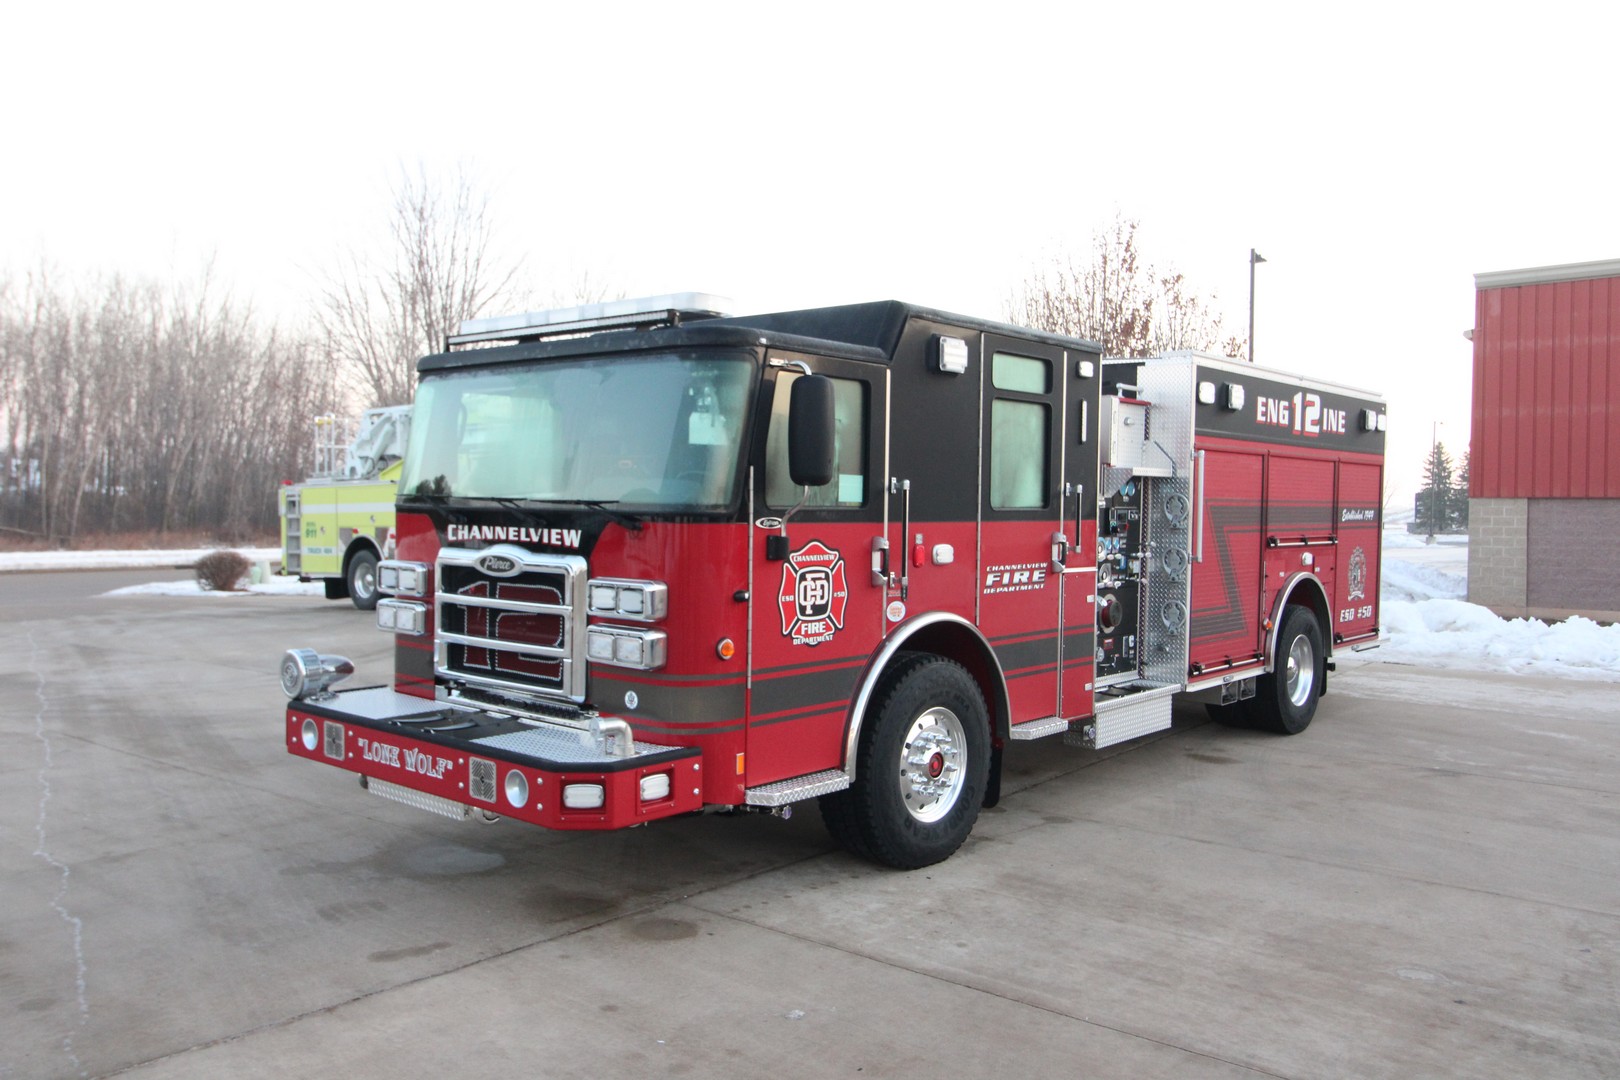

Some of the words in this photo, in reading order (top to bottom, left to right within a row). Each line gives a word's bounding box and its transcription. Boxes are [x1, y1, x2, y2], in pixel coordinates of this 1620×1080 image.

[1256, 396, 1289, 427] ENG
[1292, 392, 1321, 437] 12
[1322, 408, 1346, 434] INE
[447, 524, 582, 548] CHANNELVIEW
[484, 555, 512, 571] Pierce
[793, 554, 835, 563] CHANNELVIEW
[986, 562, 1048, 572] CHANNELVIEW
[985, 570, 1046, 587] FIRE
[983, 583, 1045, 594] DEPARTMENT
[801, 621, 826, 635] FIRE
[793, 635, 833, 645] DEPARTMENT
